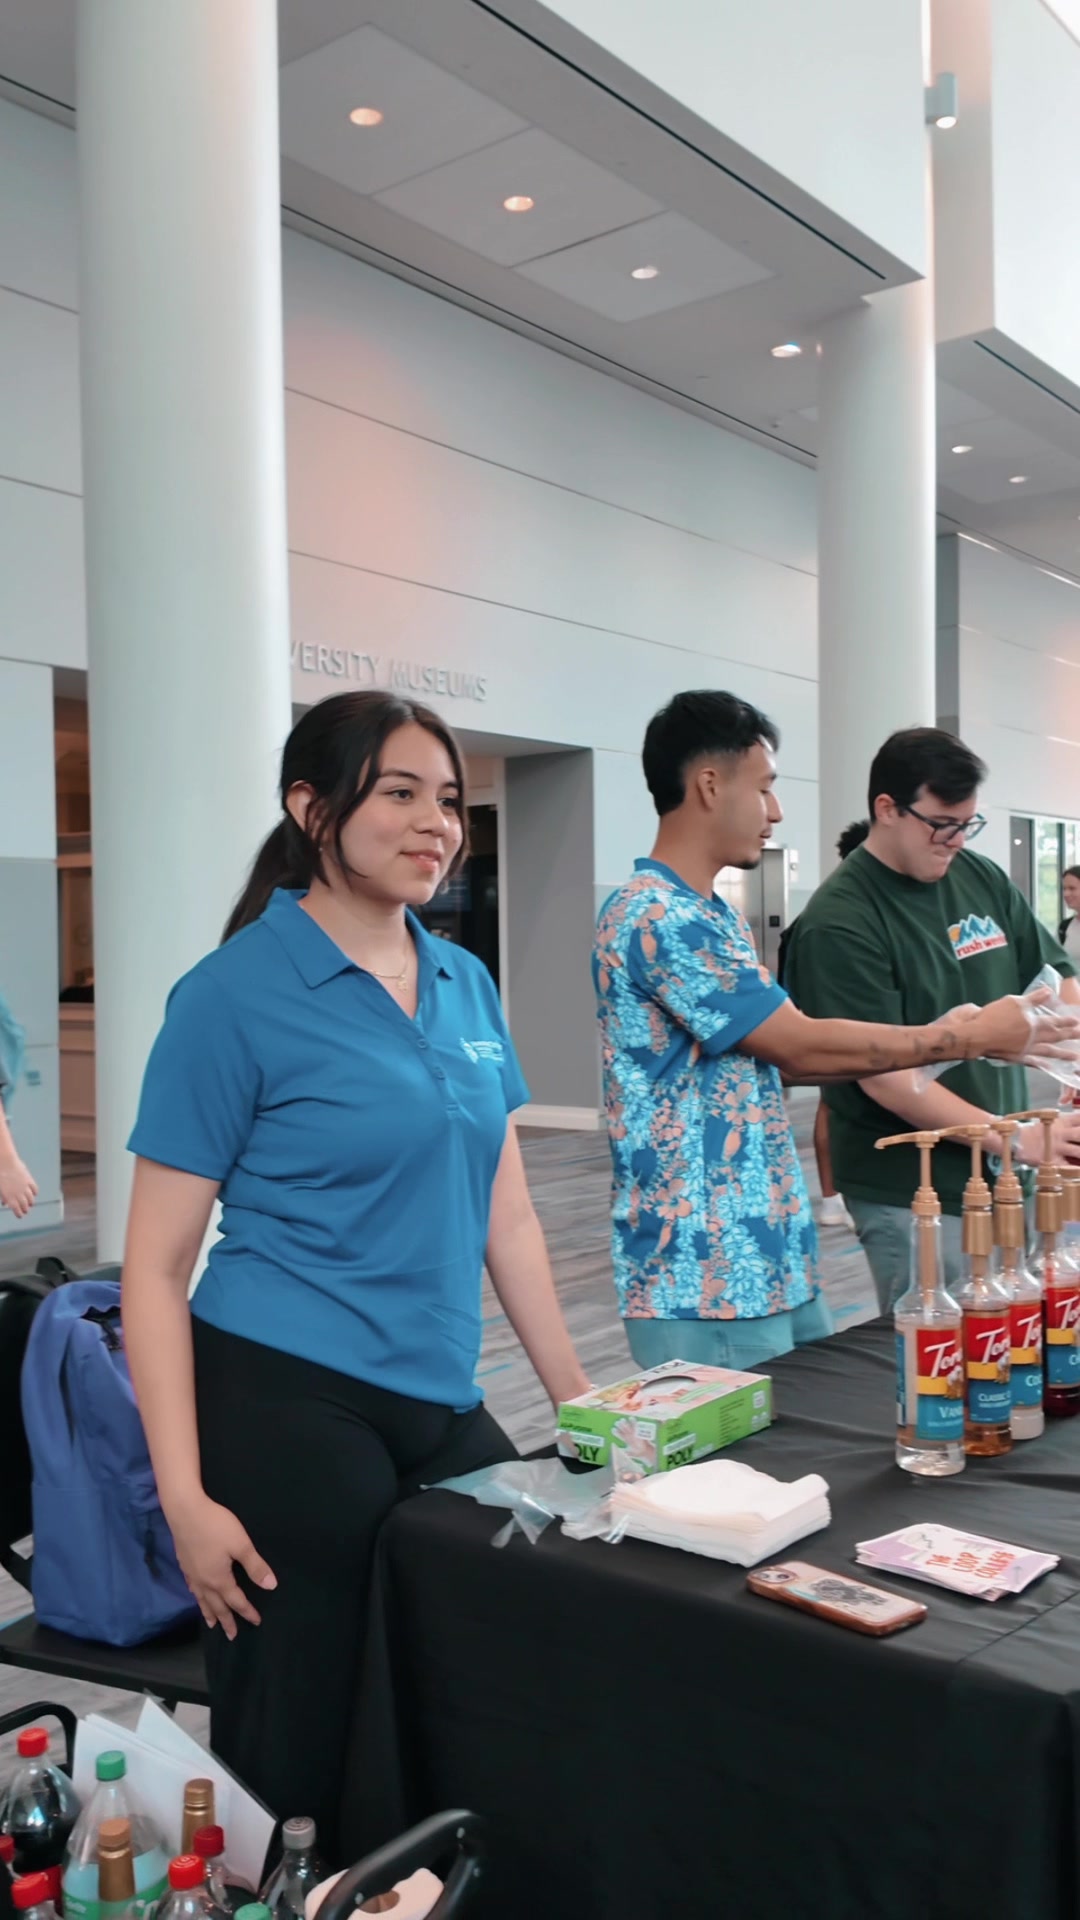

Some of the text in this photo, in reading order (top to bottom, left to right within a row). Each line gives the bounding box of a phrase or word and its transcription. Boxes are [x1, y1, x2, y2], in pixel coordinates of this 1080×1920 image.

[388, 657, 488, 701] MUSEUMS
[924, 1340, 963, 1378] Tor
[574, 1443, 600, 1462] OLY
